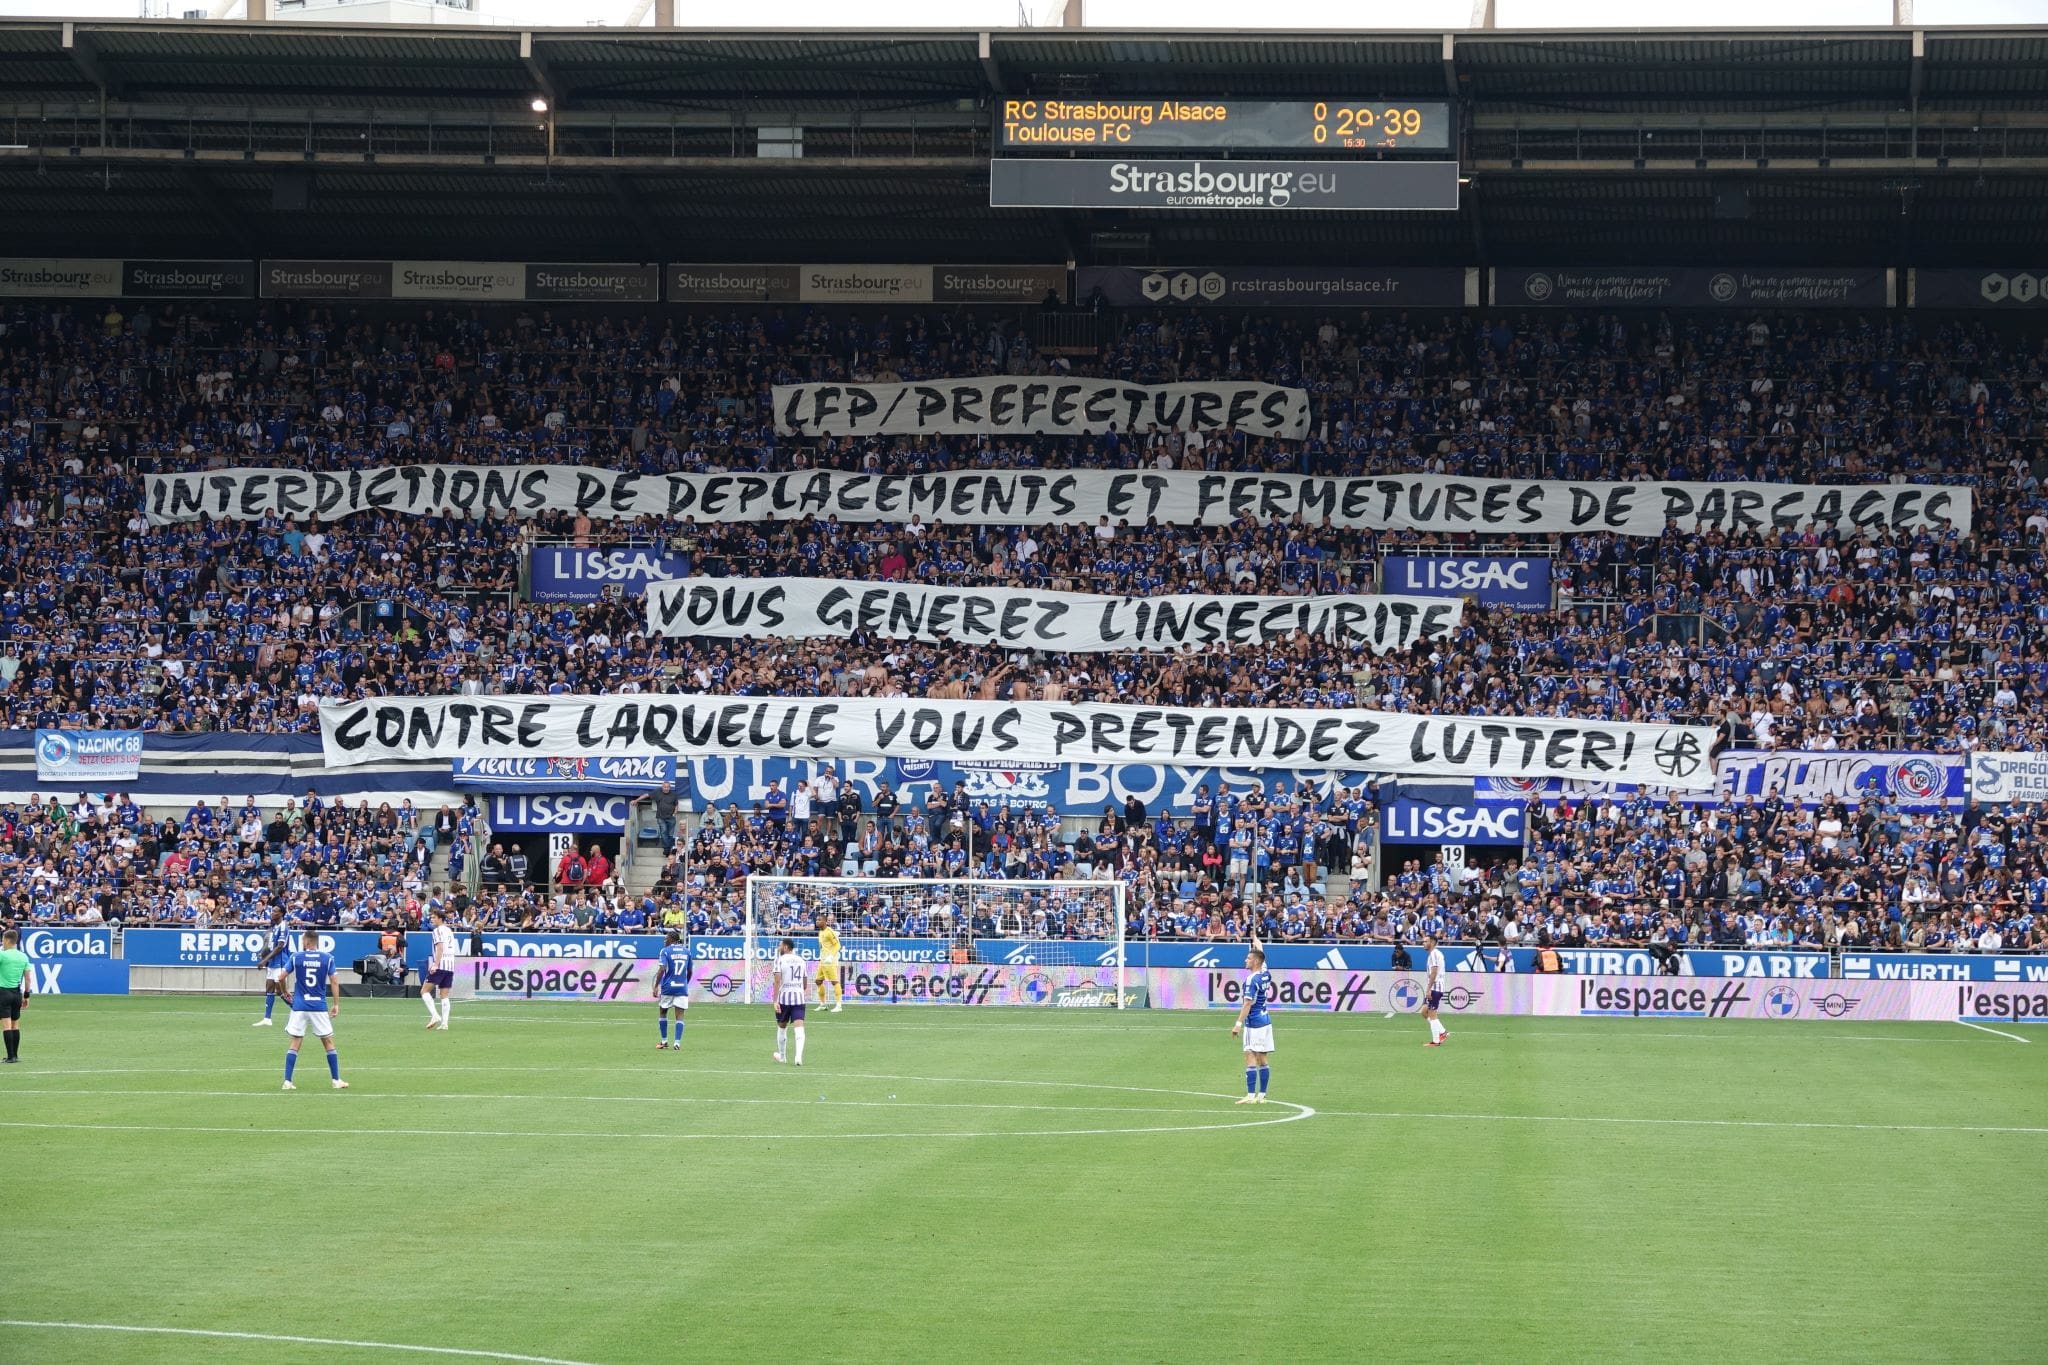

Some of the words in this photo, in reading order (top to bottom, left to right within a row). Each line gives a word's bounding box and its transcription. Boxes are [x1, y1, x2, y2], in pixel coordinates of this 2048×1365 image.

[1005, 101, 1037, 120] RC
[1045, 101, 1152, 124] Strasbourg
[1160, 101, 1226, 120] Alsace
[1314, 102, 1327, 121] 0
[1005, 122, 1095, 142] Toulouse
[1103, 122, 1131, 142] FC
[1314, 124, 1327, 143] 0
[1110, 162, 1336, 207] Strasbourg.eu
[1166, 193, 1263, 208] eurométropole
[134, 269, 245, 291] Strasbourg.eu
[271, 270, 383, 291] Strasbourg.eu
[403, 270, 515, 293] Strasbourg.eu
[536, 272, 648, 294] Strasbourg.eu
[678, 273, 790, 295] Strasbourg.eu
[811, 274, 922, 296] Strasbourg.eu
[944, 275, 1056, 296] Strasbourg.eu
[1232, 278, 1399, 295] rcstrasbourgalsace.fr
[785, 384, 1307, 430] LFP/PREFECTURES:
[154, 466, 549, 516] INTERDICTIONS
[577, 471, 641, 512] DE
[666, 471, 1077, 517] DEPLACEMENTS
[1107, 474, 1169, 517] ET
[1198, 475, 1545, 523] FERMETURES
[1568, 485, 1636, 527] DE
[1661, 488, 1951, 532] PARCAGES
[554, 552, 673, 580] LISSAC
[1408, 561, 1528, 590] LISSAC
[659, 585, 786, 628] VOUS
[817, 586, 1070, 640] GENEREZ
[1099, 597, 1453, 646] L'INSECURITE
[78, 738, 123, 752] RACING
[126, 737, 140, 750] 68
[335, 703, 550, 750] CONTRE
[577, 703, 838, 752] LAQUELLE
[876, 708, 1021, 752] VOUS
[1051, 711, 1380, 763] PRETENDEZ
[1410, 721, 1635, 771] LUTTER!
[78, 755, 99, 765] JETZT
[599, 757, 667, 779] Garde
[1770, 756, 1873, 799] BLANC
[496, 796, 626, 827] LISSAC
[1387, 807, 1519, 838] LISSAC
[552, 836, 570, 850] 18
[1444, 847, 1462, 861] 19
[26, 931, 106, 959] Carola
[180, 953, 240, 962] copieurs
[251, 953, 258, 961] &
[674, 959, 685, 975] 17
[1722, 954, 1819, 979] PARK
[306, 967, 317, 987] 5
[475, 961, 597, 998] l'espace
[790, 965, 801, 981] 14
[1876, 963, 1970, 980] WÜRTH
[840, 966, 963, 1003] l'espace
[1580, 979, 1706, 1016] l'espace
